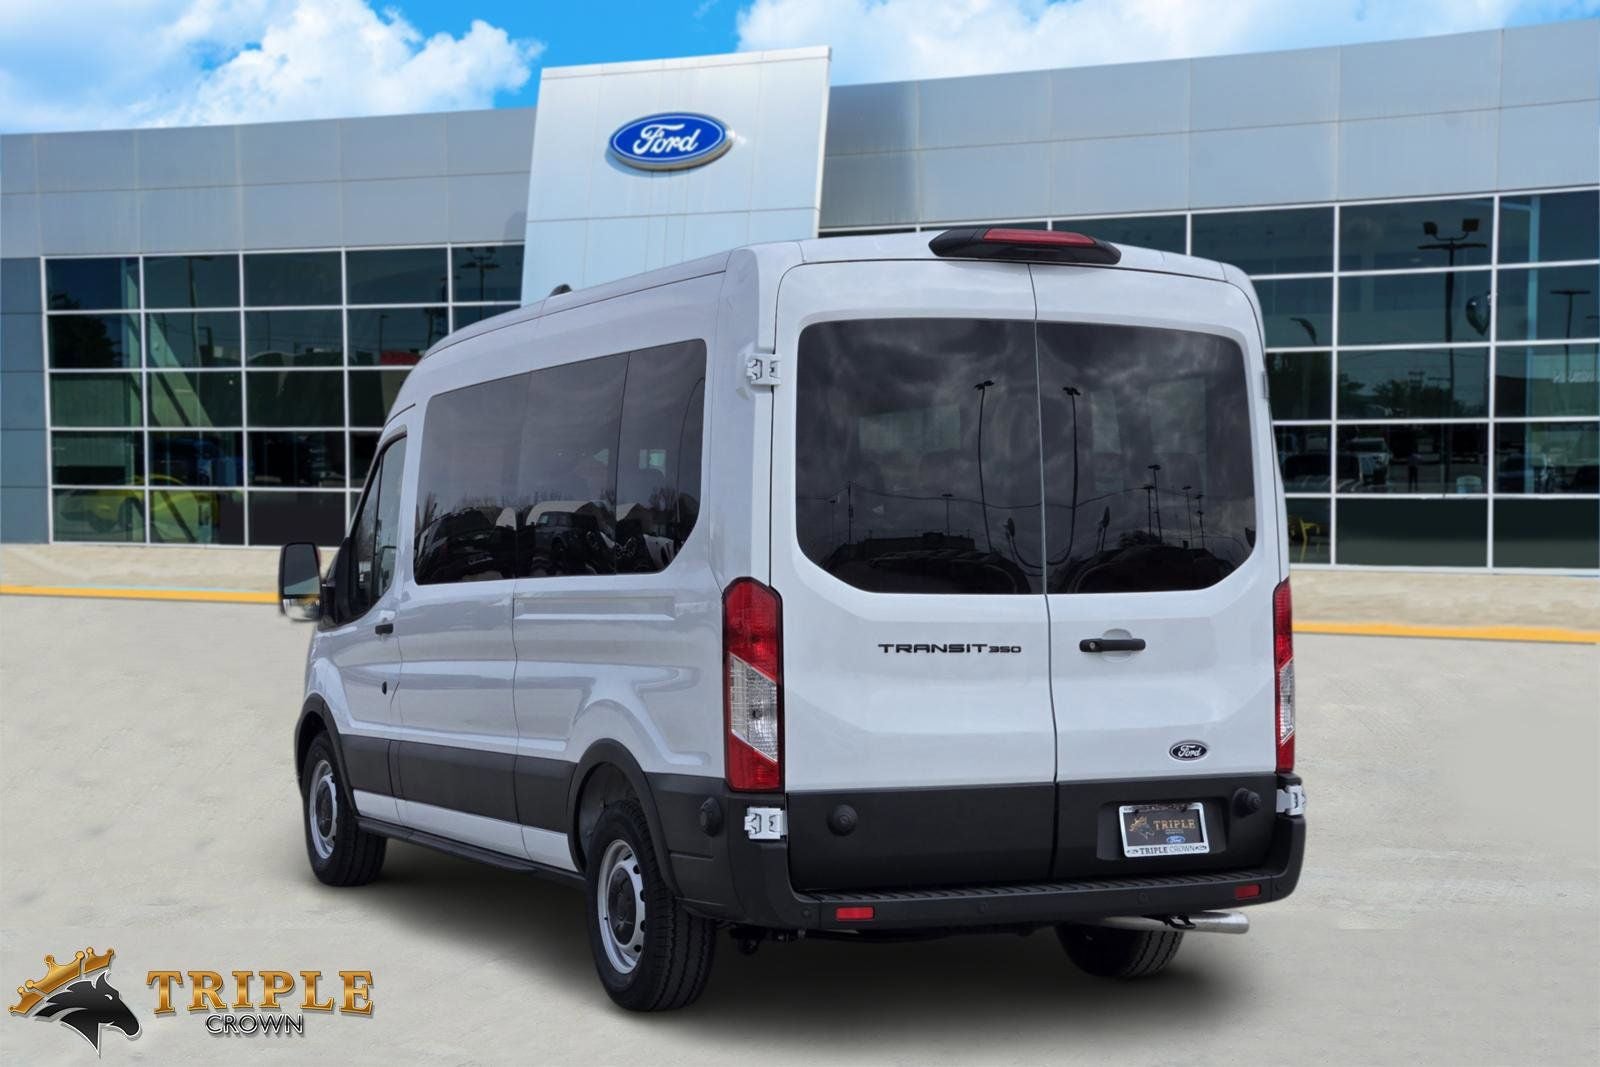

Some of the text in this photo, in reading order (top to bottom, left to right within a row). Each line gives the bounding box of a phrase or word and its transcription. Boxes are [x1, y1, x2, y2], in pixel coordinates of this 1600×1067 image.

[632, 123, 702, 155] Ford
[878, 643, 1022, 654] TRANSIT 350
[1178, 744, 1202, 758] Ford
[1152, 819, 1196, 831] TRIPLE
[1140, 844, 1196, 855] TRIPLE CROWN
